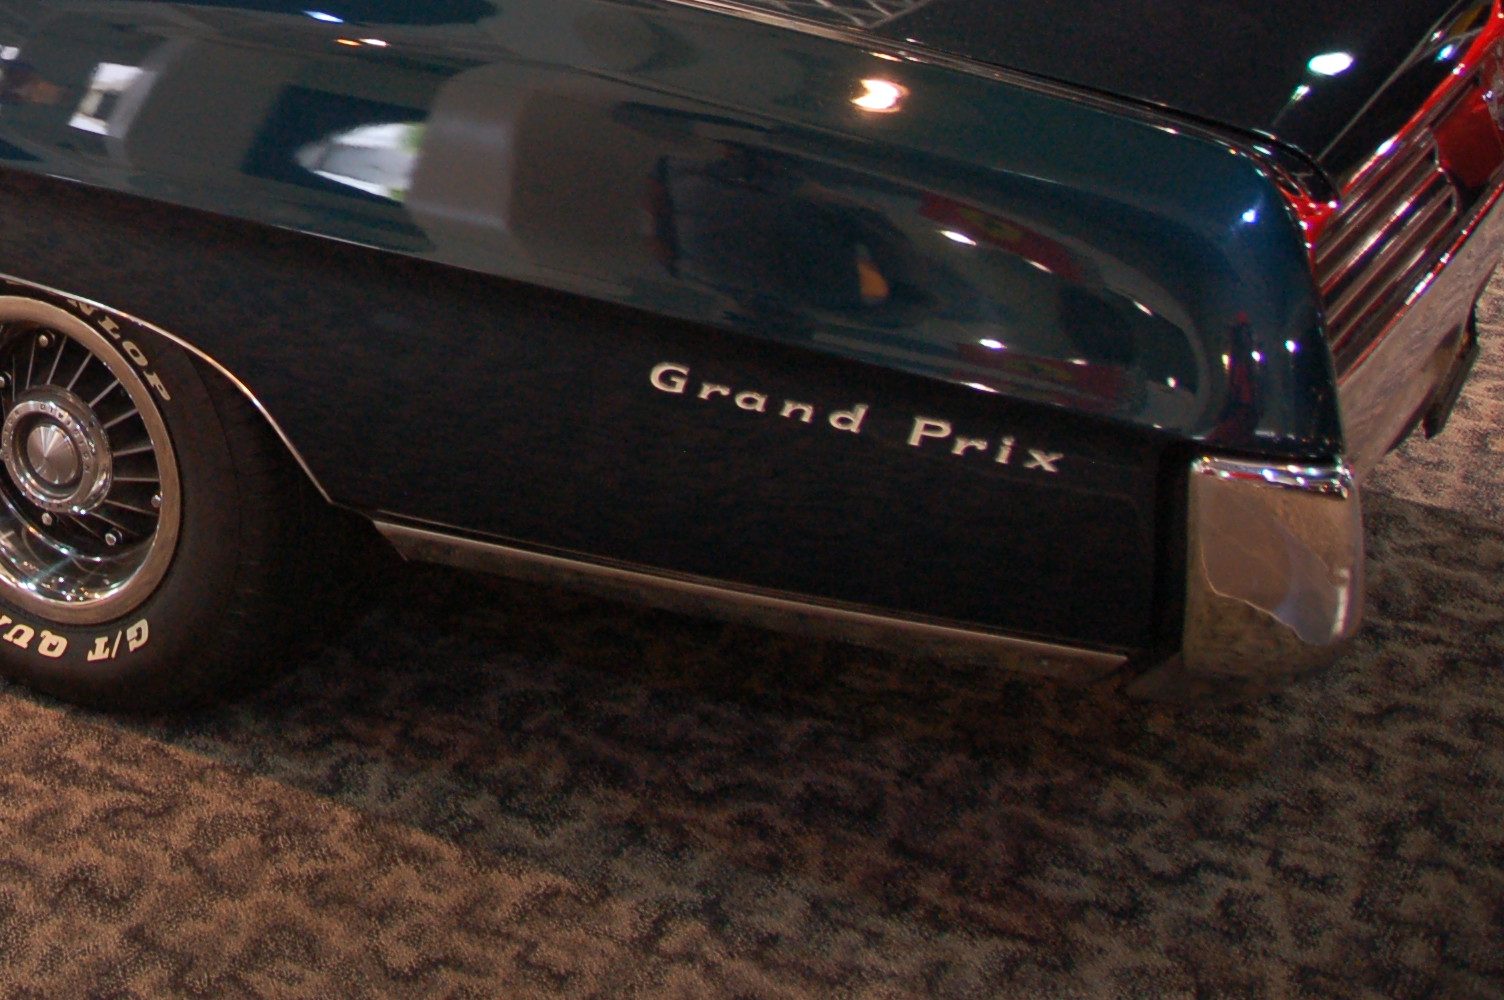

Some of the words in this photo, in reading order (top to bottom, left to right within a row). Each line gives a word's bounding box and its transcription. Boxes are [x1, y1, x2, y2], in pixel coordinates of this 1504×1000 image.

[648, 360, 872, 436] Grand
[905, 413, 1066, 474] Prix
[86, 617, 149, 662] G/T
